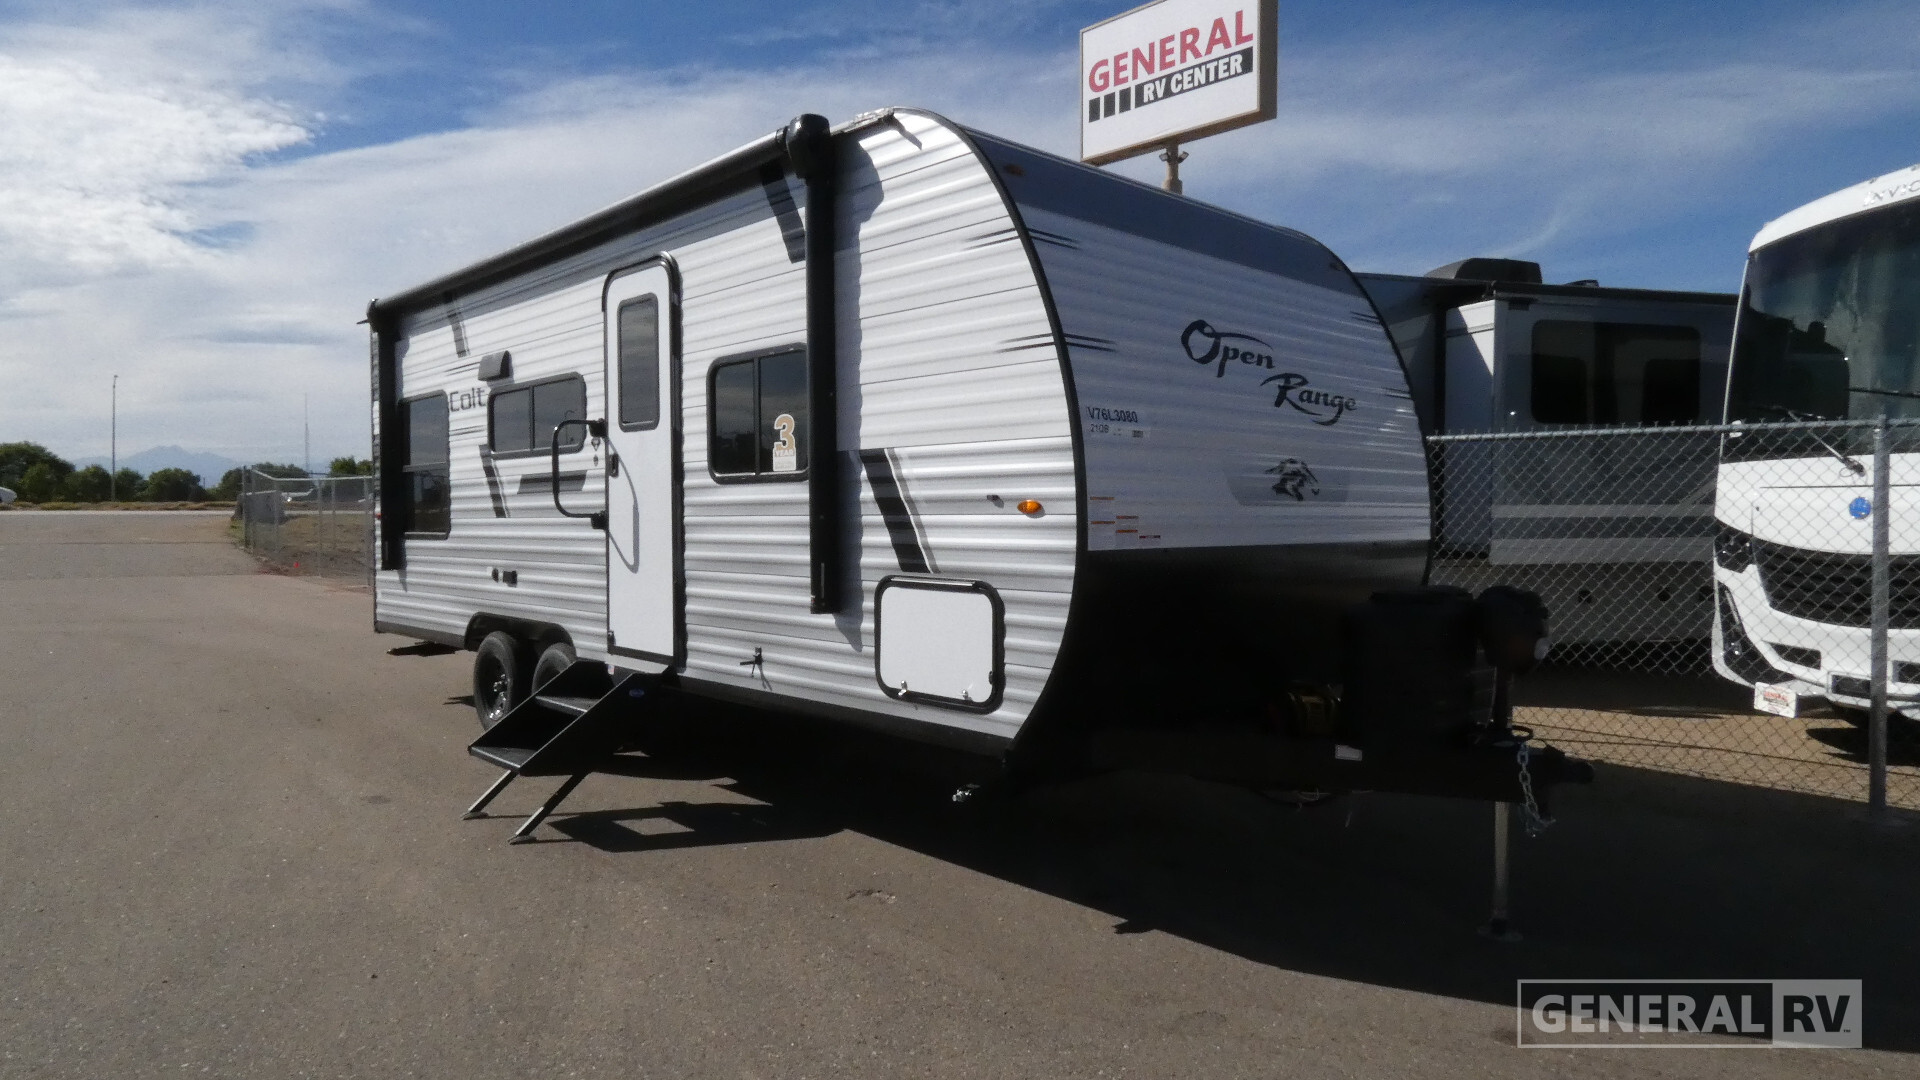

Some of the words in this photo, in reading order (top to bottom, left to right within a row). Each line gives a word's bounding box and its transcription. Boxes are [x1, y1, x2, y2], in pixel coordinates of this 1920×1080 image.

[1089, 10, 1253, 93] GENERAL
[1143, 78, 1166, 103] RV
[1171, 54, 1243, 94] CENTER
[1181, 319, 1275, 378] Open
[450, 387, 486, 412] Colt
[1086, 406, 1138, 423] V76L3080
[1260, 373, 1357, 426] Range
[774, 413, 796, 451] 3
